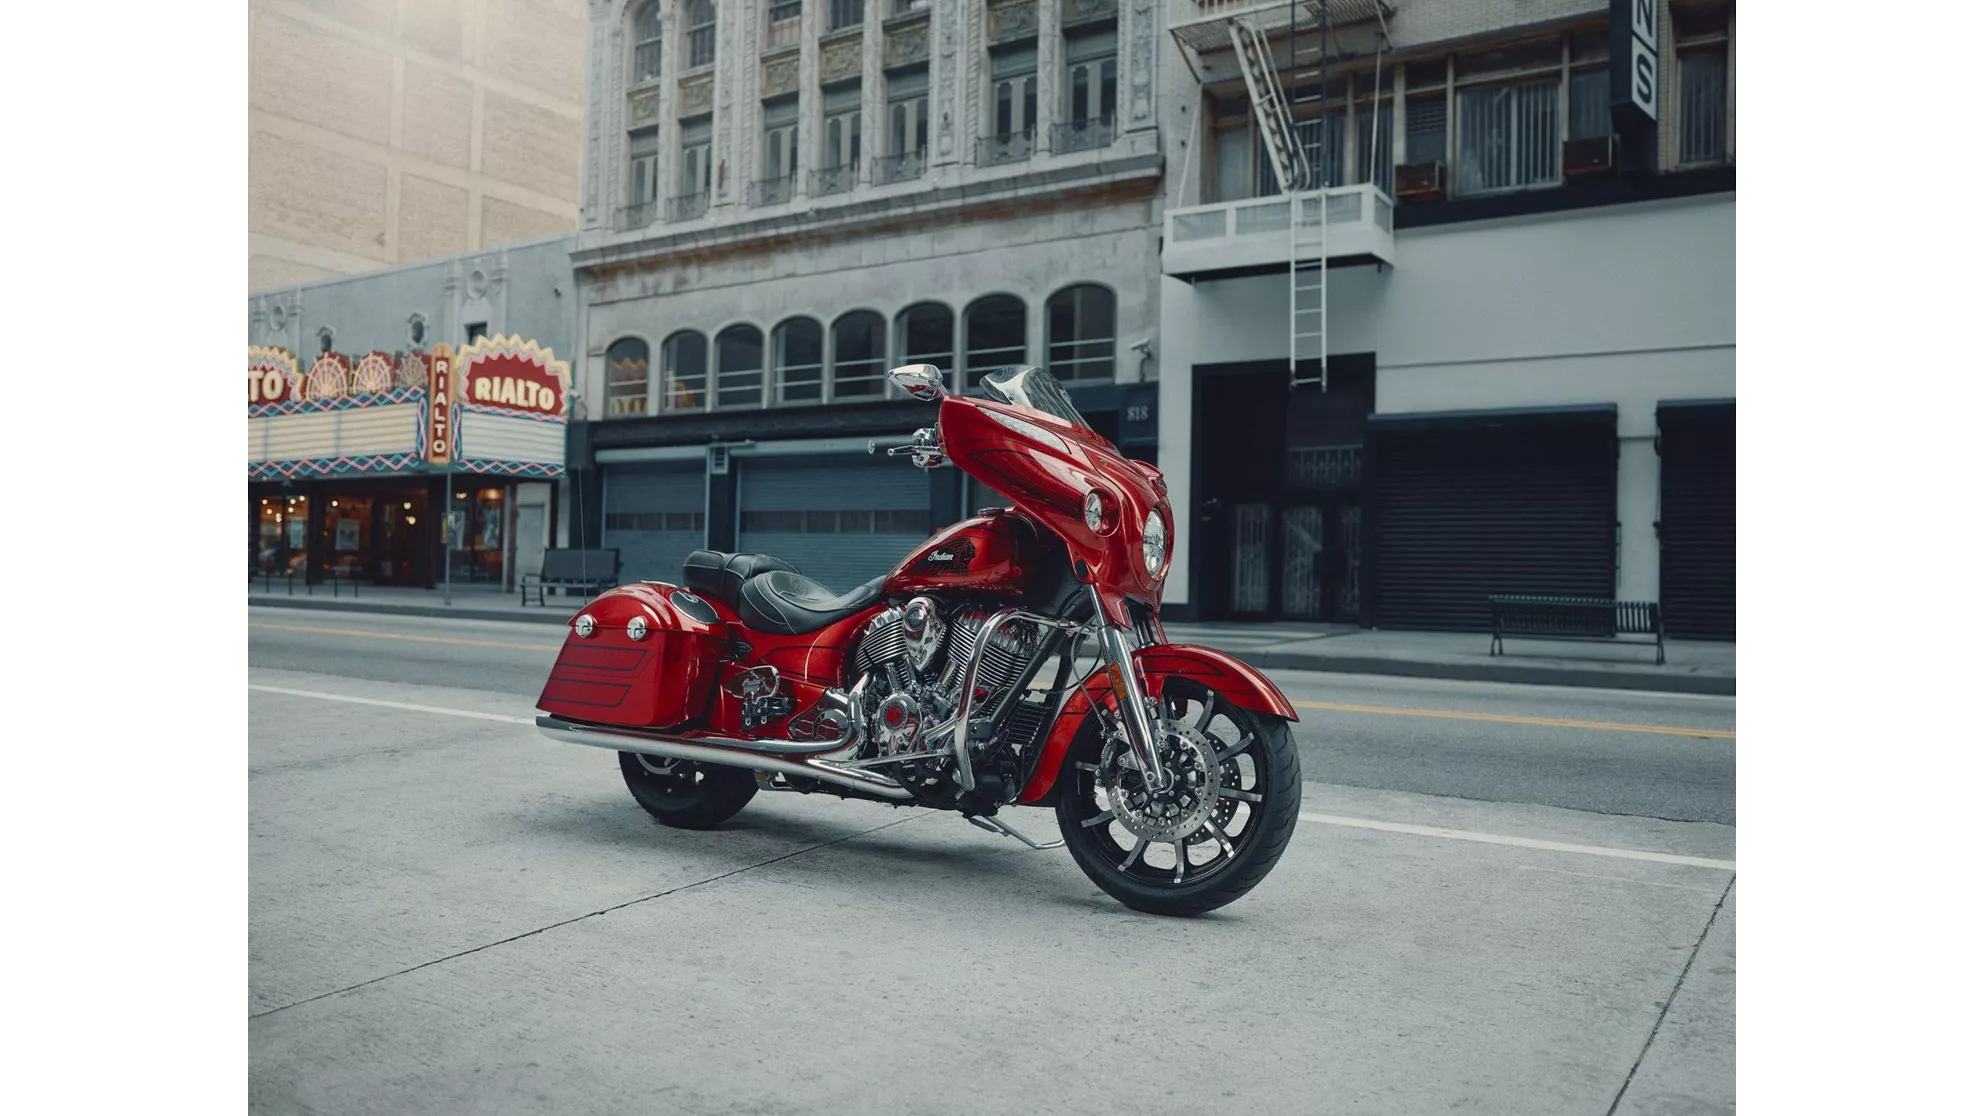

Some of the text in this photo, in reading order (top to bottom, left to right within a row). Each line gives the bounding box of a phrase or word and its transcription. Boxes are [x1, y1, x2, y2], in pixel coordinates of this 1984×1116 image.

[248, 370, 283, 402] TO
[475, 376, 555, 411] RIALTO
[433, 361, 448, 453] RIALTO
[1127, 405, 1148, 421] 818
[928, 550, 953, 562] Indian
